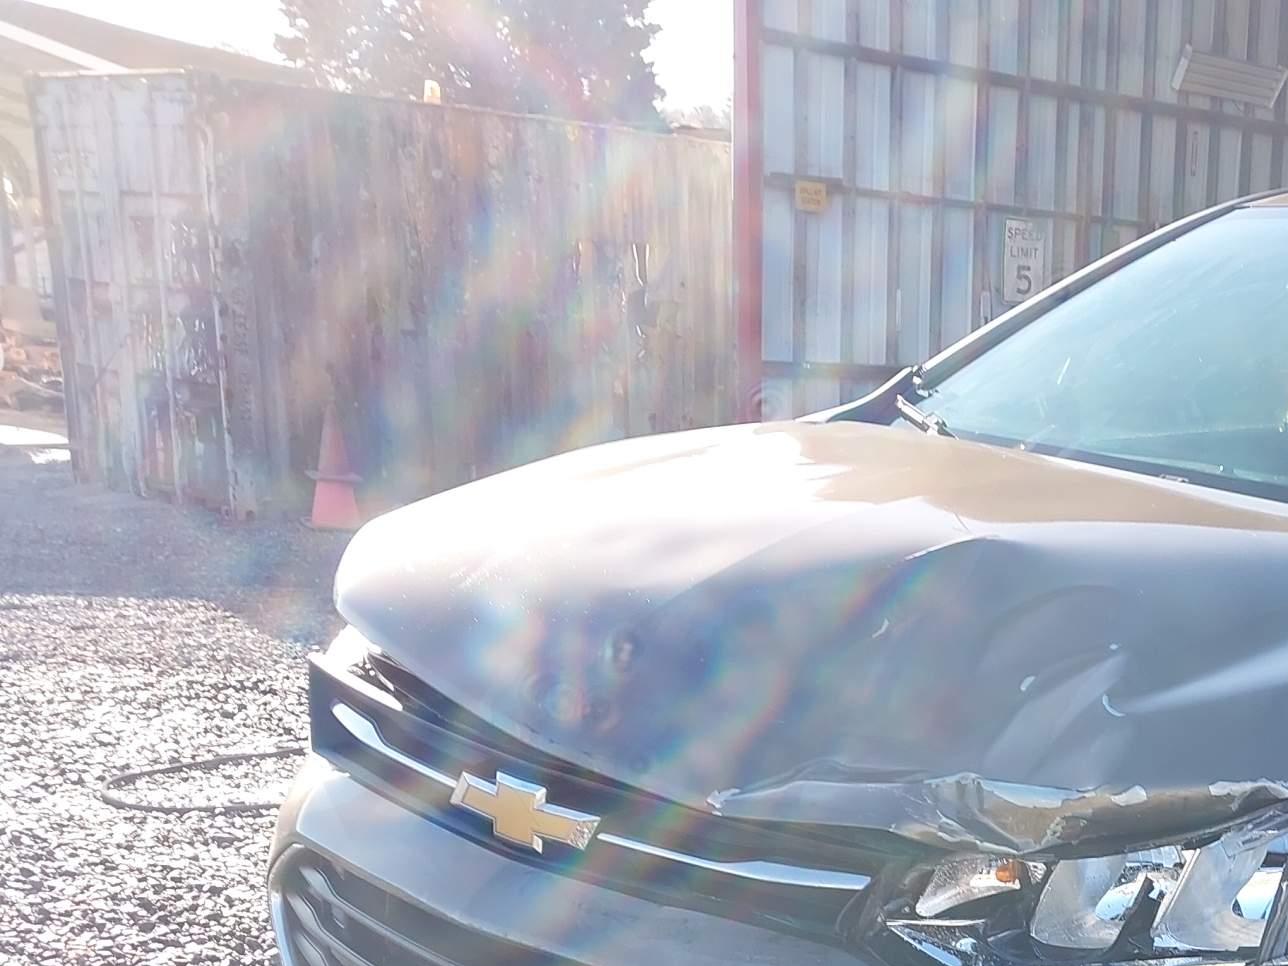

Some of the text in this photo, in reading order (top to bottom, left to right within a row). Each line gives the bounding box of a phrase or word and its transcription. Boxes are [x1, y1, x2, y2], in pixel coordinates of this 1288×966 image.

[1007, 226, 1043, 241] SPEED
[1009, 246, 1039, 259] LIMIT
[1016, 264, 1032, 295] 5
